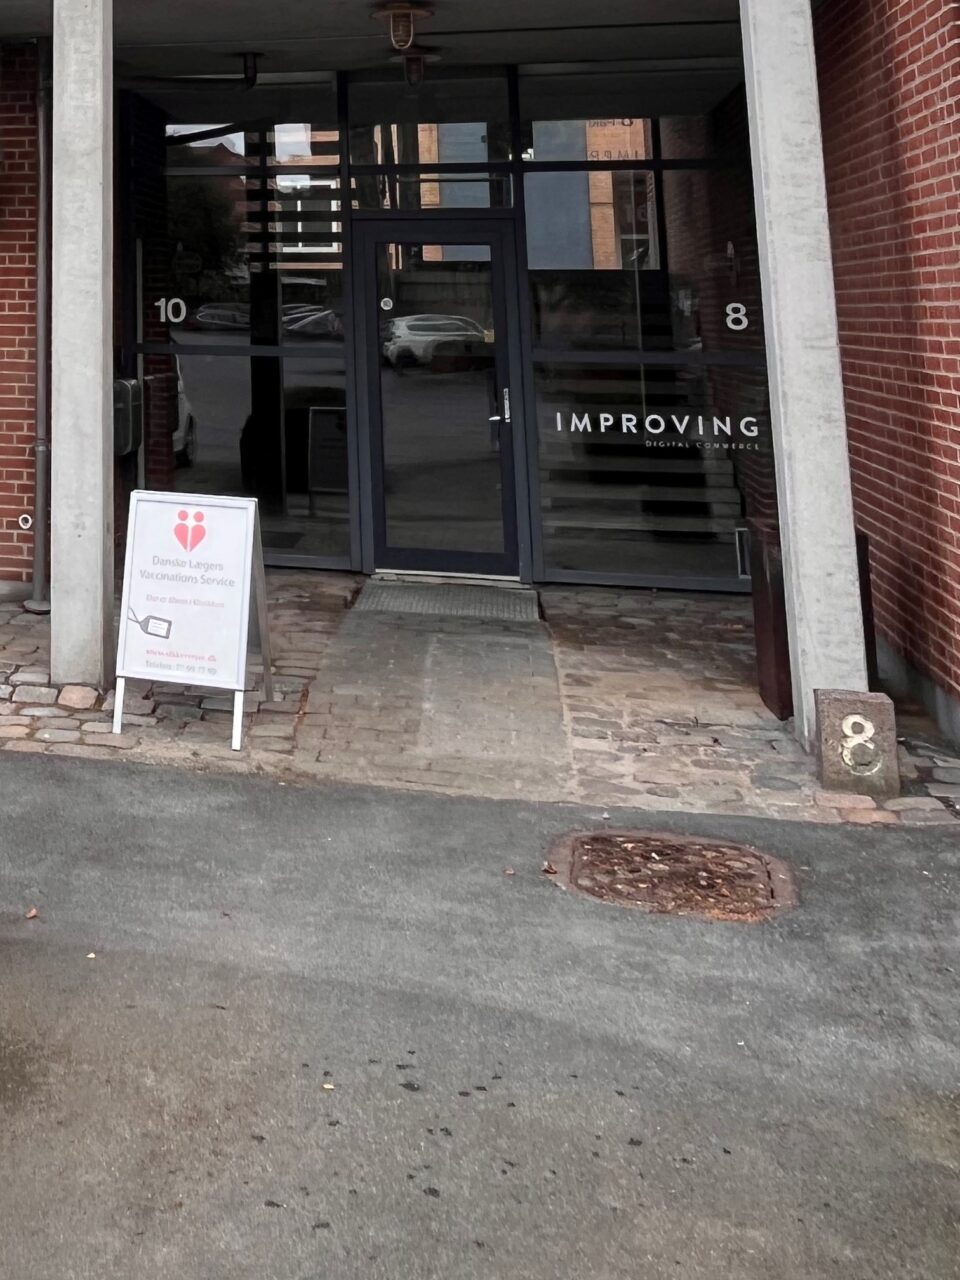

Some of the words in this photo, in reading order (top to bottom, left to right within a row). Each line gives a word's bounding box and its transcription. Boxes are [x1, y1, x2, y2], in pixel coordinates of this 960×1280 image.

[154, 297, 187, 323] 10
[725, 302, 749, 330] 8
[556, 412, 759, 437] IMPROVING
[645, 440, 690, 449] DIGITAL
[152, 555, 187, 569] Danske
[188, 560, 224, 573] Lægers
[139, 568, 199, 584] Vaccinations
[200, 574, 236, 587] Service
[842, 714, 882, 776] 8
